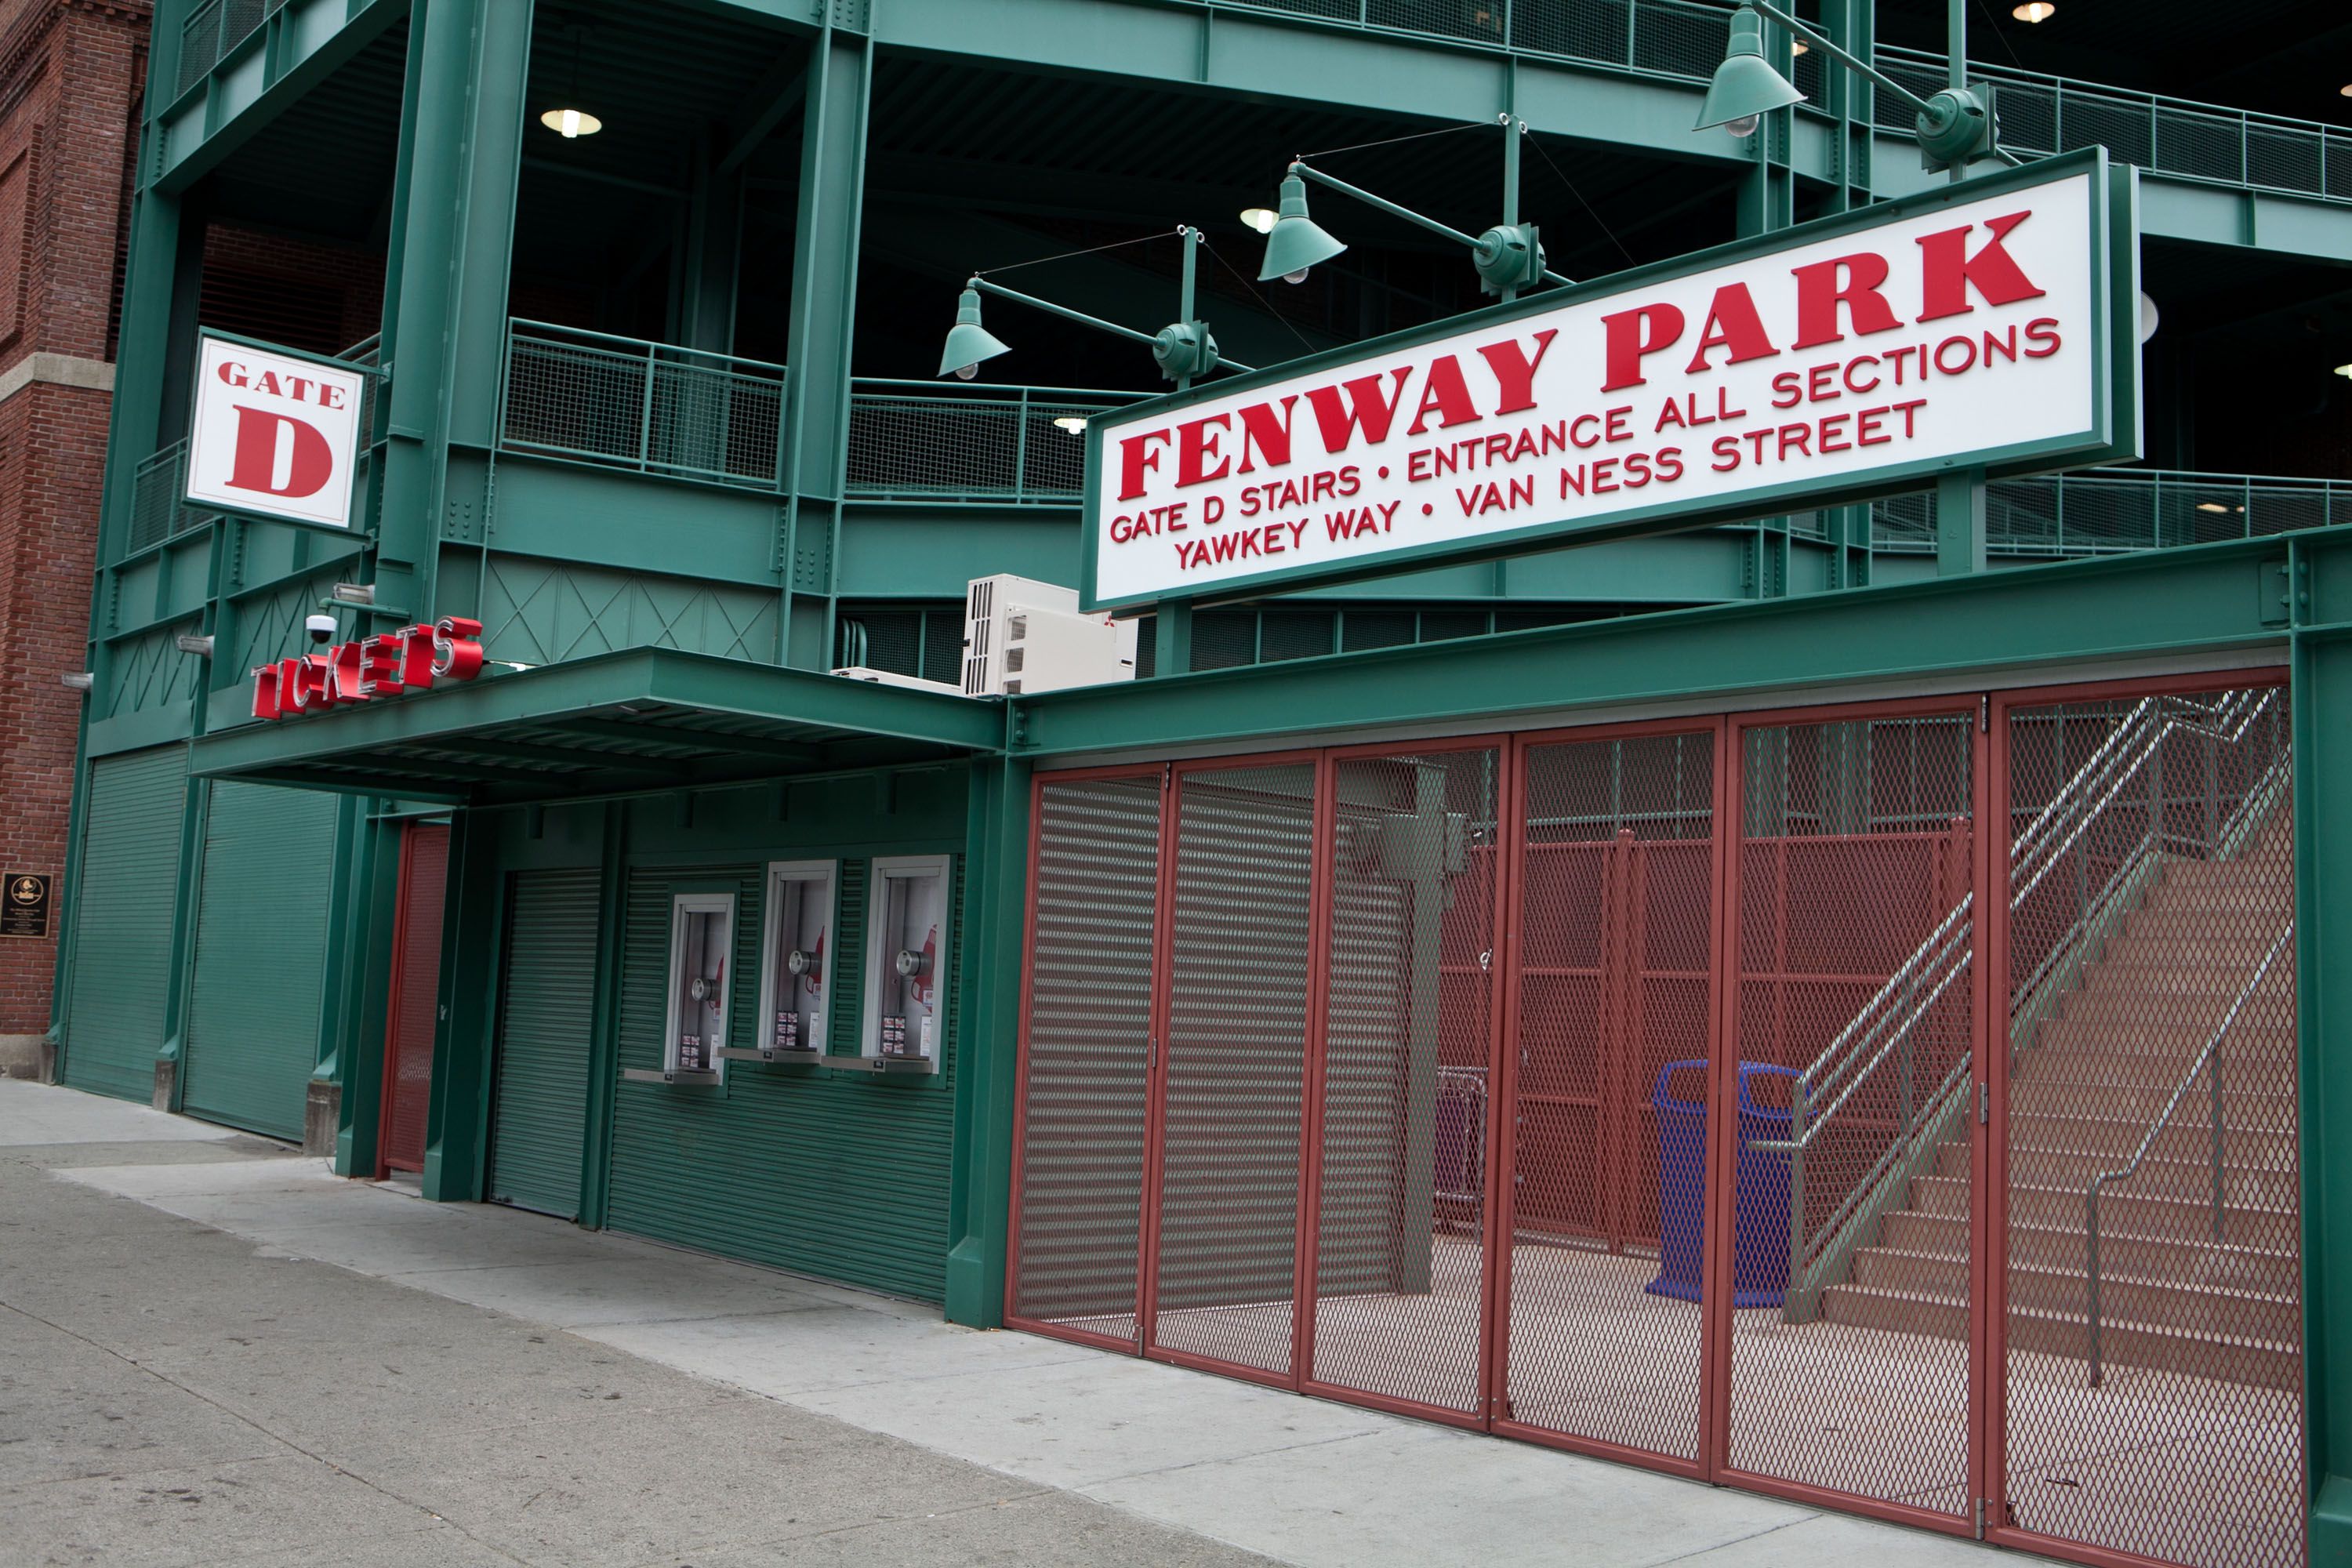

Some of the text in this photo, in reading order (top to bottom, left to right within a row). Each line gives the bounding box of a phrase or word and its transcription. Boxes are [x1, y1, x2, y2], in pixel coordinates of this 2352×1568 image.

[218, 361, 346, 411] GATE
[1116, 210, 2045, 501] FENWAY PARK
[224, 404, 333, 498] D
[1110, 318, 2061, 543] GATE D STAIRS ENTRANCE ALL SECTIONS
[1174, 398, 1927, 569] YAWKEY WAY VAN NESS STREET
[251, 615, 483, 720] TICKETS
